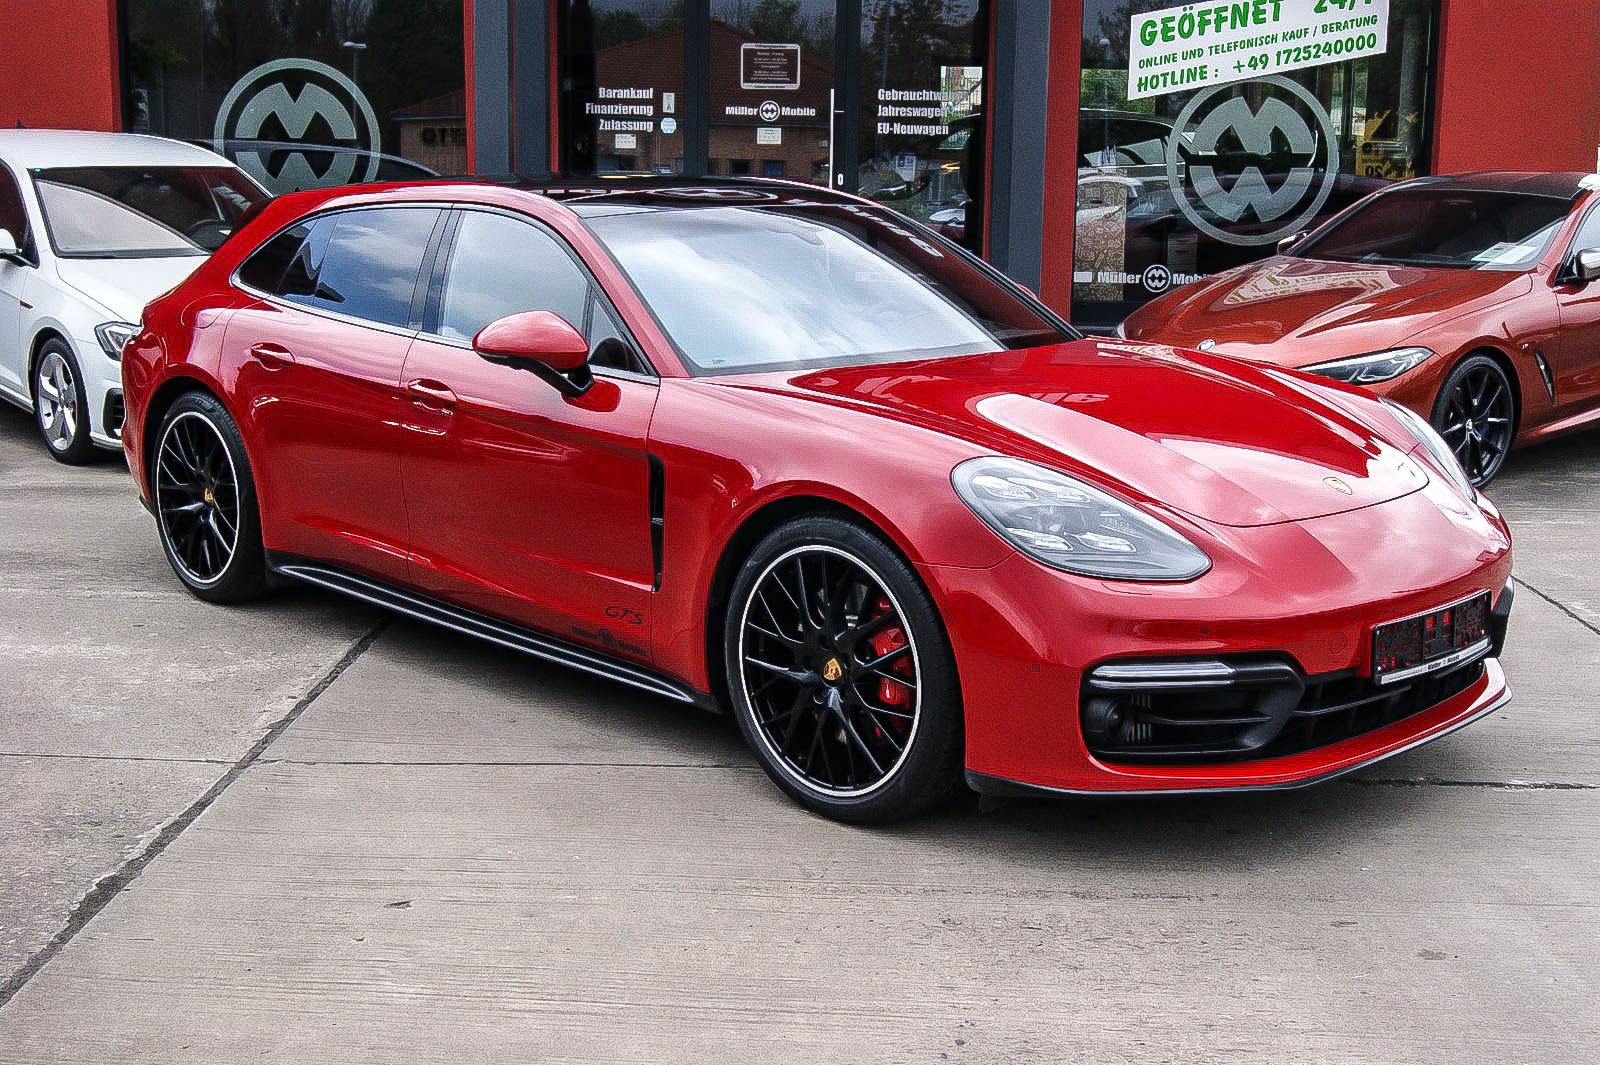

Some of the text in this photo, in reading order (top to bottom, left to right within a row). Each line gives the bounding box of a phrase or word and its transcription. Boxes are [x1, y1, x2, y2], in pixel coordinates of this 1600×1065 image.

[1140, 0, 1281, 46] GEÖFFNET
[1138, 53, 1178, 69] ONLINE
[1181, 48, 1204, 60] UND
[1207, 33, 1279, 56] TELEFONISCH
[1282, 27, 1310, 42] KAUF
[1321, 14, 1378, 34] BERATUNG
[1137, 64, 1208, 92] HOTLINE
[1232, 53, 1269, 73] +49
[1275, 32, 1377, 66] 1725240000
[598, 87, 654, 99] Barankauf
[585, 103, 654, 116] Finanzierung
[725, 105, 758, 116] Müller
[781, 106, 816, 117] Mobile
[878, 105, 948, 118] Jahreswagen
[599, 118, 654, 132] Zulassung
[877, 122, 949, 136] EU-Neuwagen
[1097, 271, 1142, 284] Müller
